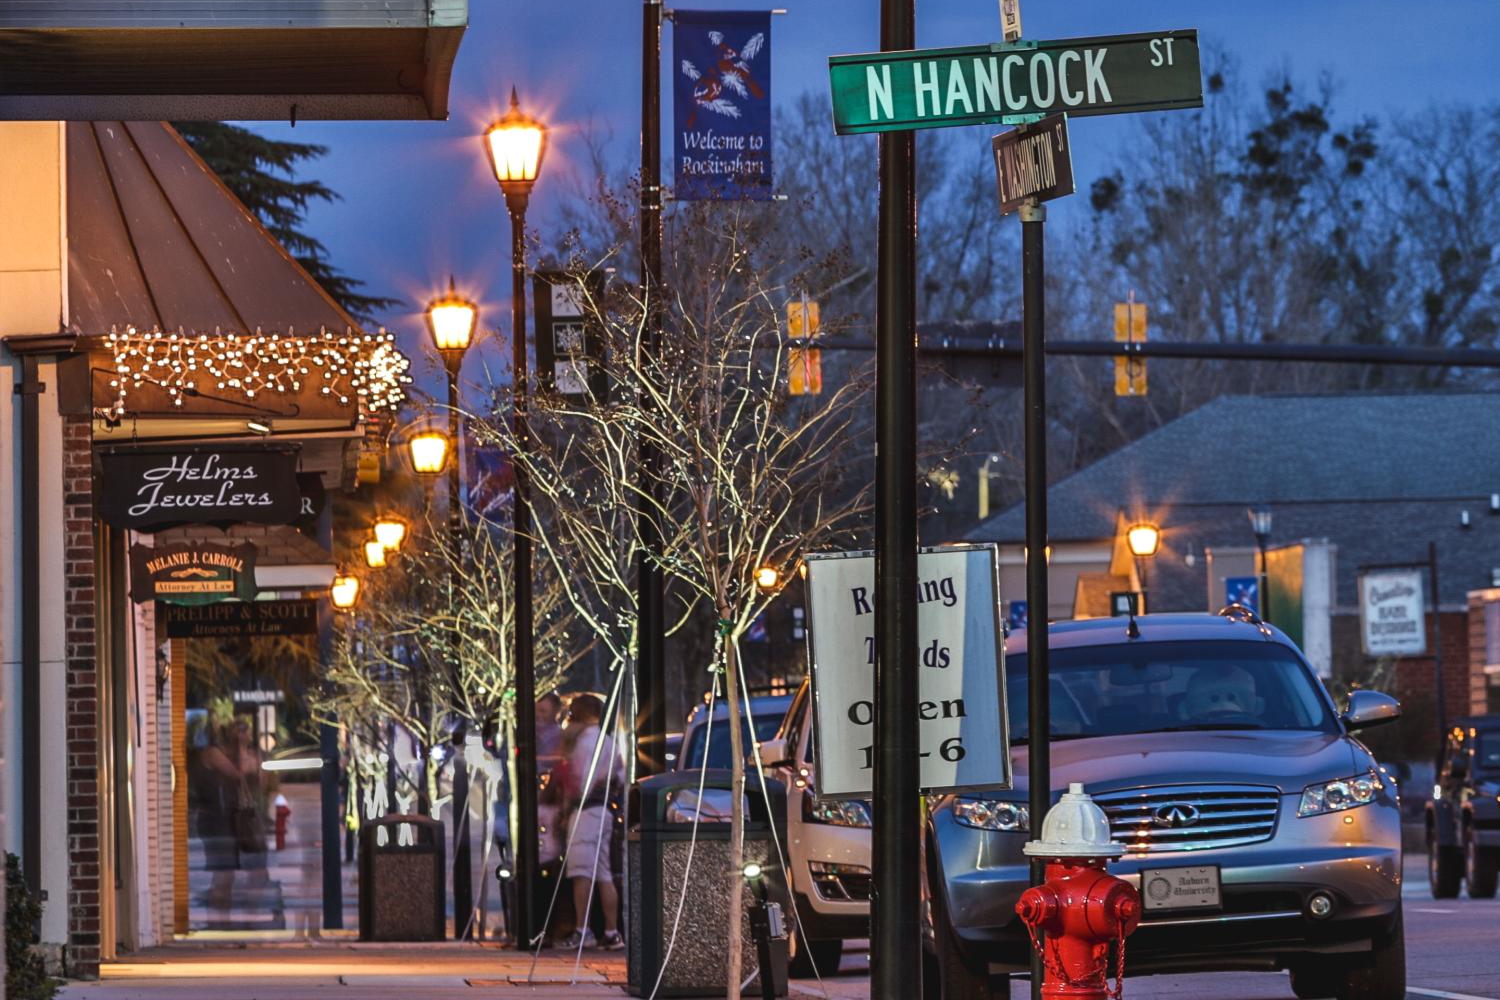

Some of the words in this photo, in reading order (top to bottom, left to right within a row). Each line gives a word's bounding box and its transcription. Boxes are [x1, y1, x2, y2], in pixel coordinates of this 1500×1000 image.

[866, 64, 894, 120] N
[912, 48, 1113, 117] HANCOCK
[1150, 37, 1175, 67] ST
[683, 128, 745, 150] Welcome
[750, 134, 763, 150] to
[682, 153, 764, 182] Rockingham
[997, 149, 1006, 203] E
[1003, 131, 1057, 200] WASHINGTON
[143, 454, 258, 482] Helms
[128, 480, 273, 516] Jewelers
[146, 552, 190, 574] MELANIE
[192, 552, 199, 564] J.
[202, 552, 244, 572] CARROLL
[158, 583, 196, 592] Attorney
[200, 583, 210, 591] At
[214, 582, 232, 590] Law
[240, 605, 251, 619] &
[259, 604, 310, 618] SCOTT
[192, 623, 240, 634] Attorneys
[261, 622, 281, 633] Law
[847, 698, 968, 726] Oen
[1174, 886, 1217, 896] University
[1178, 876, 1210, 886] Auburn
